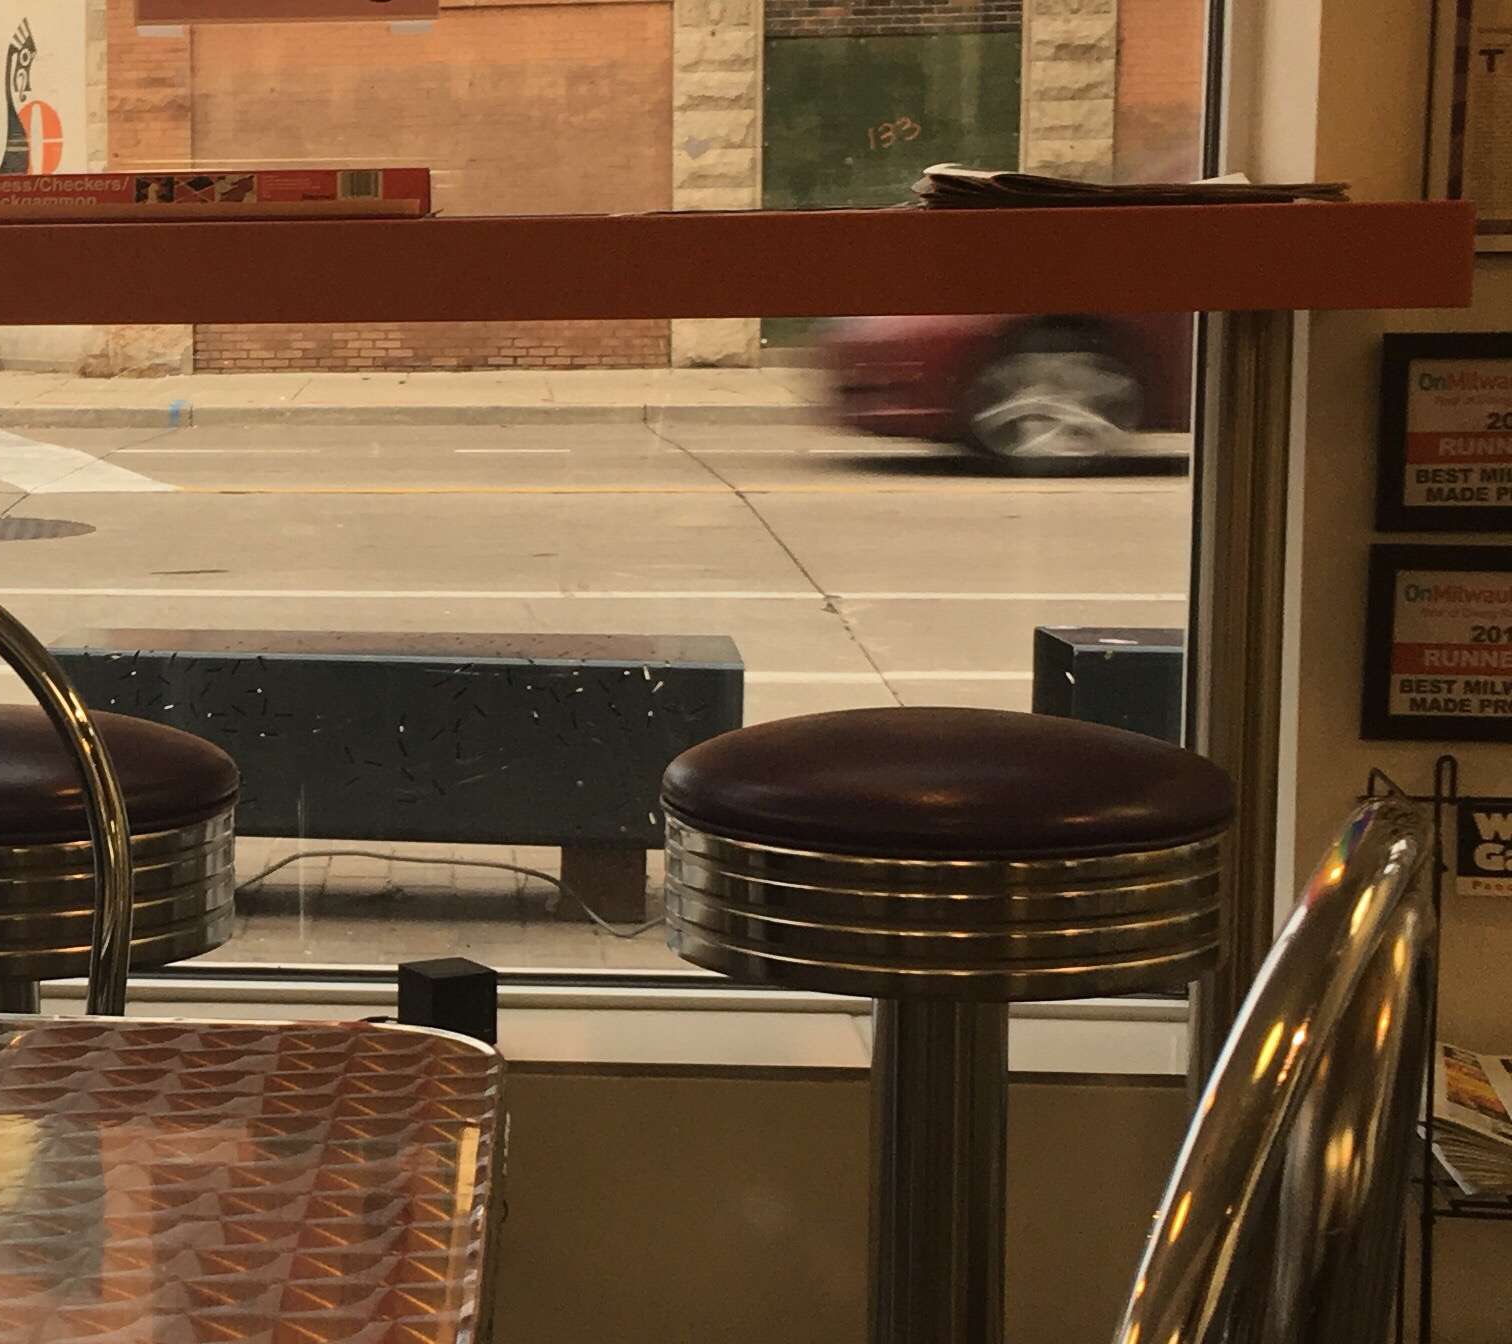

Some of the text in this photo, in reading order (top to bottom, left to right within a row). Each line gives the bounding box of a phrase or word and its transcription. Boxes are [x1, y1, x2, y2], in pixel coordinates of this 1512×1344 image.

[868, 116, 921, 150] 133
[1415, 469, 1472, 484] BEST
[1425, 487, 1488, 502] MADE
[1399, 679, 1457, 694] BEST
[1408, 698, 1471, 712] MADE
